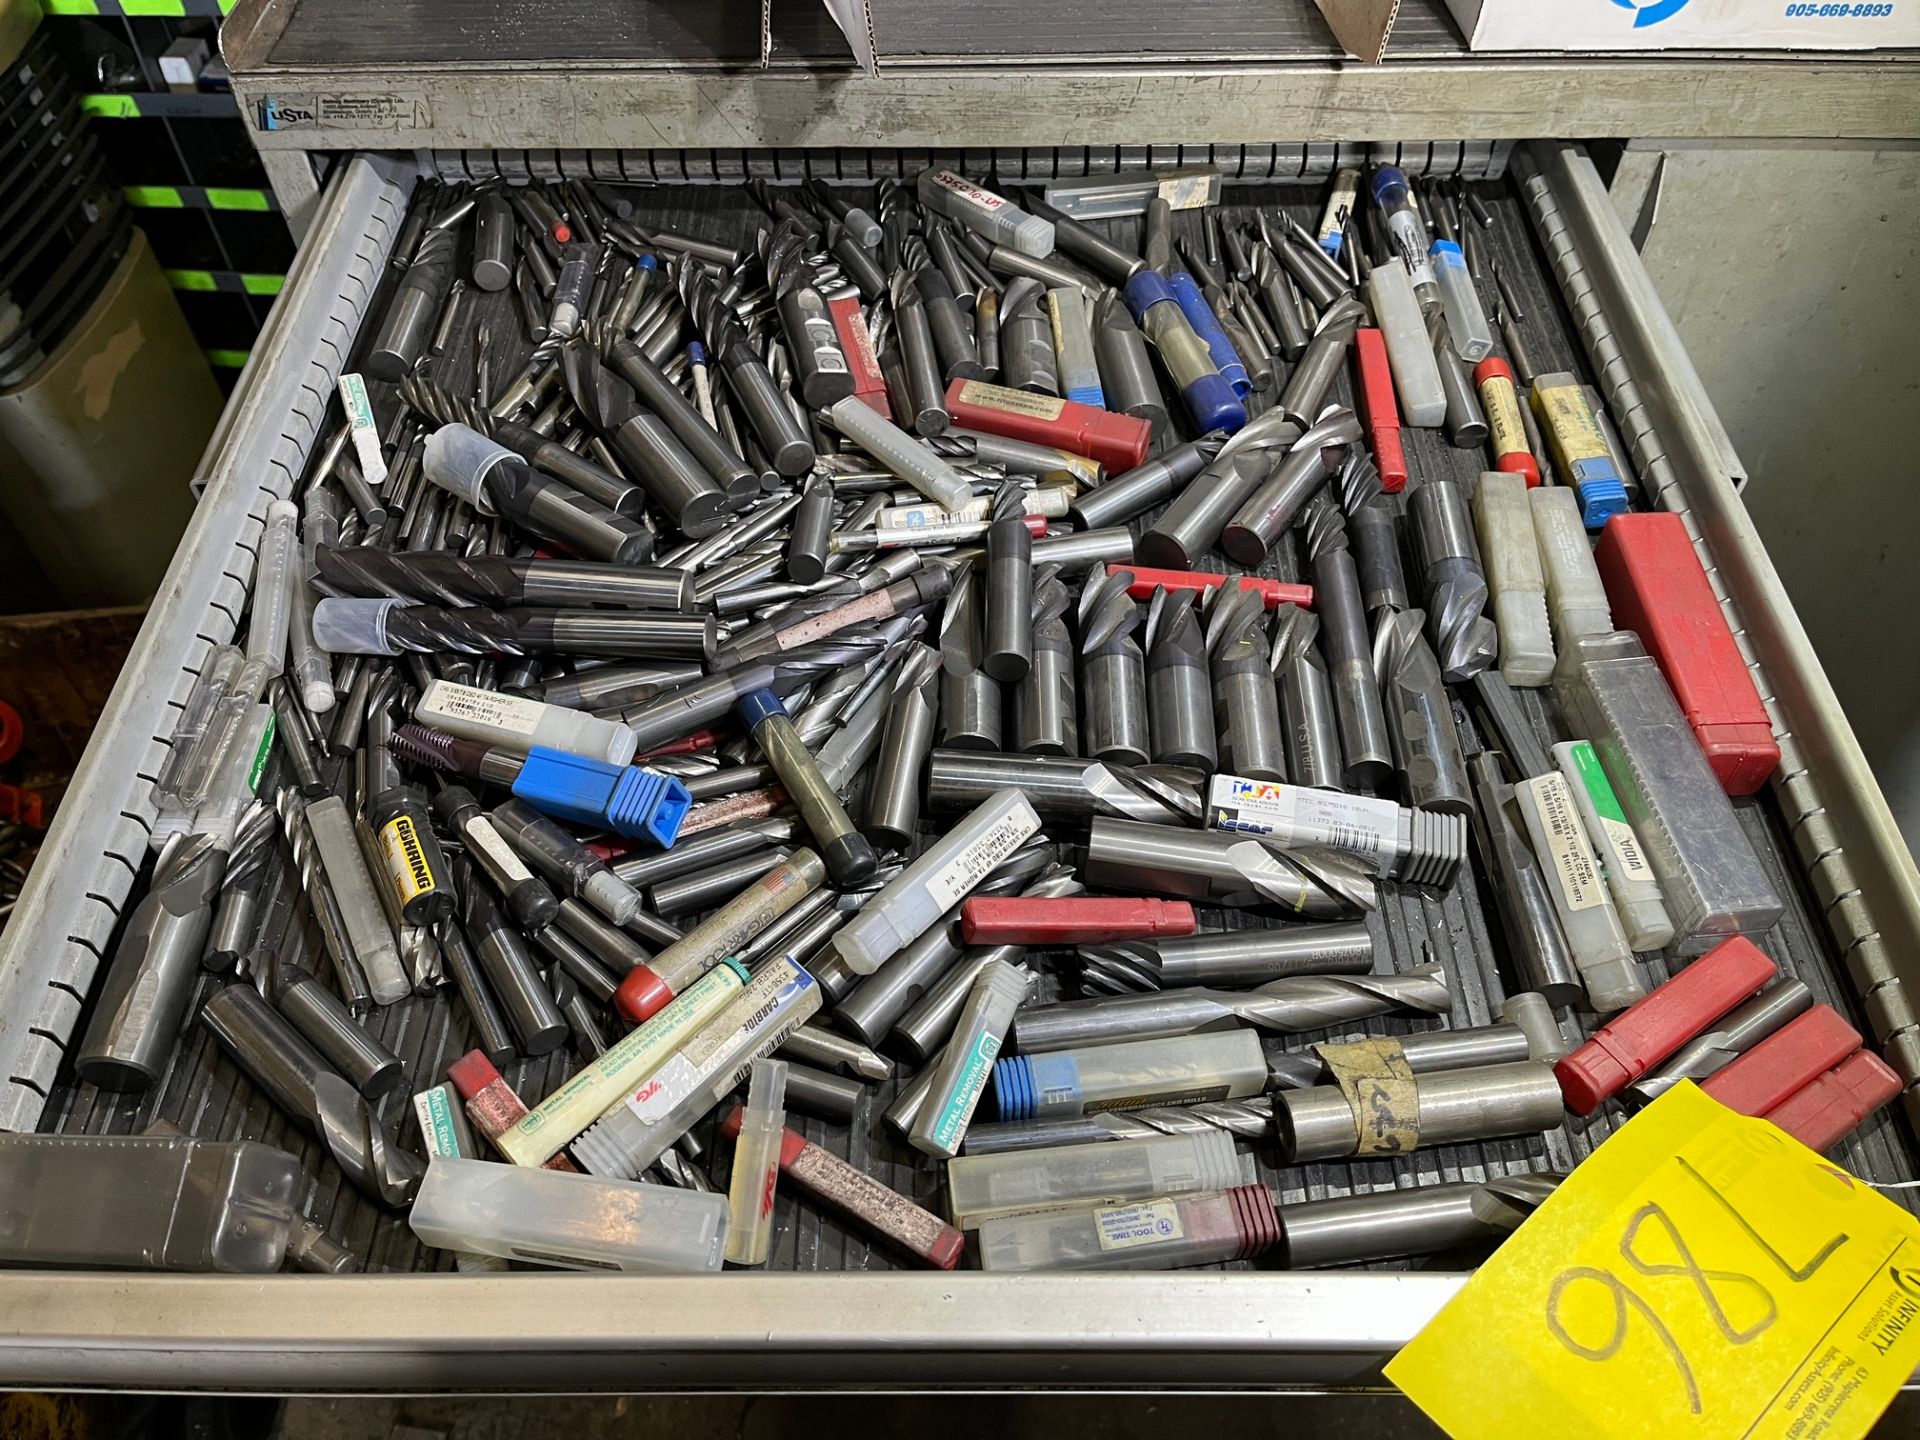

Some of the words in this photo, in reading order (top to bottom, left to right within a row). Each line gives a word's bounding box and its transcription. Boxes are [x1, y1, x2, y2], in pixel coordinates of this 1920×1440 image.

[1784, 2, 1893, 17] 905-669-8893
[270, 108, 314, 122] LISTA
[1618, 838, 1643, 871] WIDIA
[1577, 871, 1588, 885] SEM
[723, 917, 762, 952] GARR
[695, 942, 731, 973] TOOL
[740, 995, 781, 1034] CARBIDE
[429, 1091, 445, 1125] METAL
[937, 1106, 961, 1143] METAL
[953, 1057, 984, 1107] REMOVAL
[1111, 1230, 1130, 1240] TIME
[1132, 1226, 1154, 1237] TOOL
[1881, 1287, 1904, 1309] Asset
[1855, 1305, 1890, 1343] Solutions
[1867, 1297, 1920, 1357] INFINITY
[1782, 1343, 1841, 1413] InfinityAssets.com
[1827, 1354, 1855, 1384] Phone:
[1853, 1365, 1870, 1380] 63
[1809, 1378, 1836, 1405] (905)
